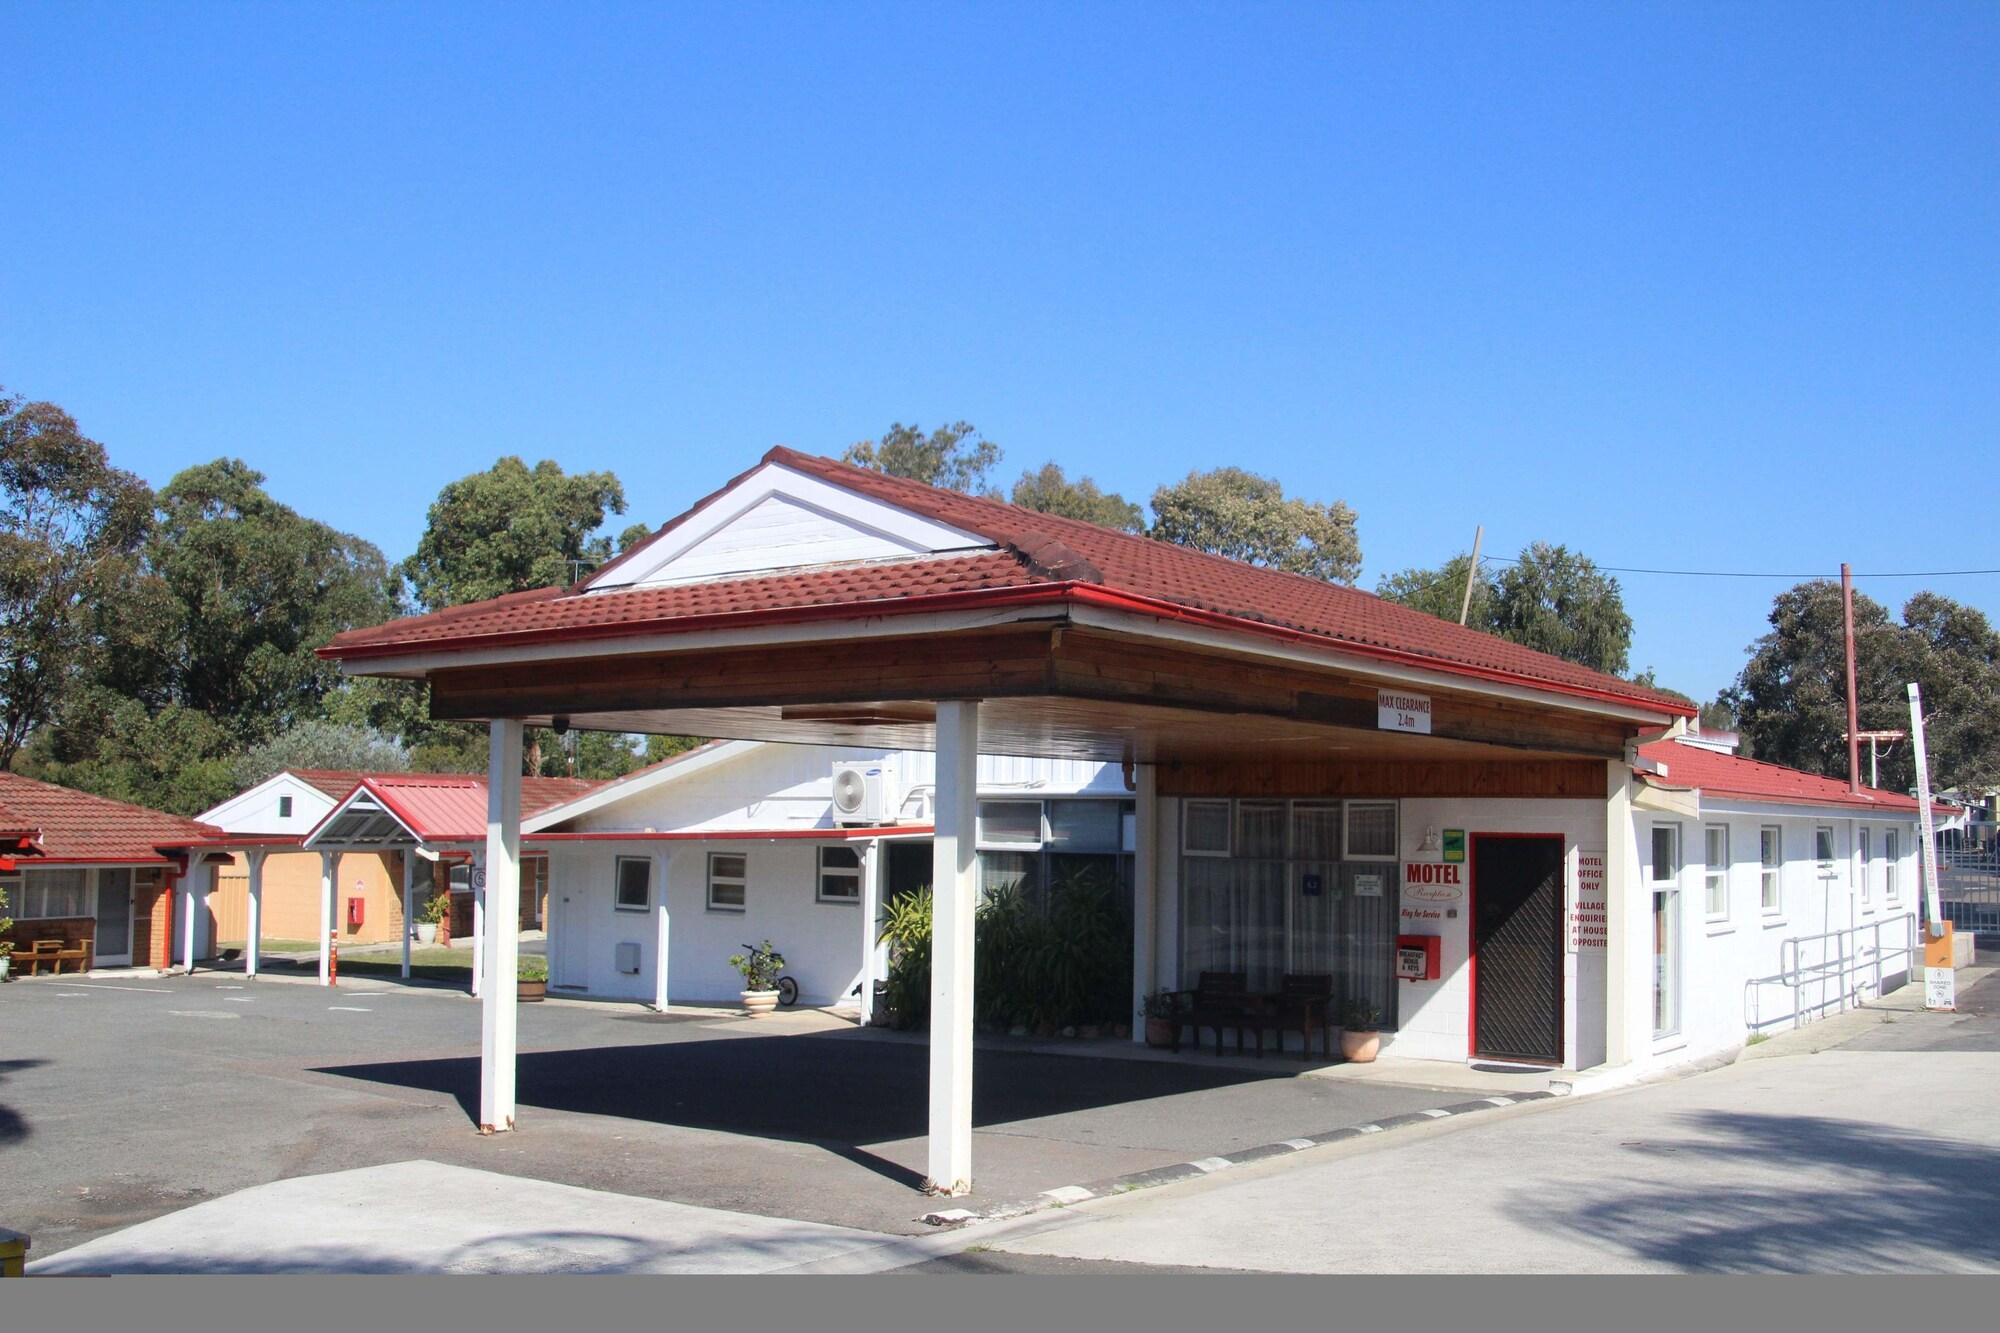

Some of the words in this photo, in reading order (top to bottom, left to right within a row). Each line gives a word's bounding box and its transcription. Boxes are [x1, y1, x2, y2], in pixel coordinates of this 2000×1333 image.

[1379, 695, 1394, 709] MAX
[1396, 697, 1429, 713] CLEARANCE
[1398, 713, 1415, 727] 2.4m
[1407, 864, 1460, 884] MOTEL
[1578, 870, 1604, 878] OFFICE
[1581, 882, 1600, 890] ONLY
[1575, 902, 1605, 910] VILLAGE
[1570, 914, 1607, 923] ENQUIRIE
[1572, 927, 1581, 935] AT
[1584, 926, 1607, 935] HOUSE
[1573, 938, 1607, 947] OPPOSITE
